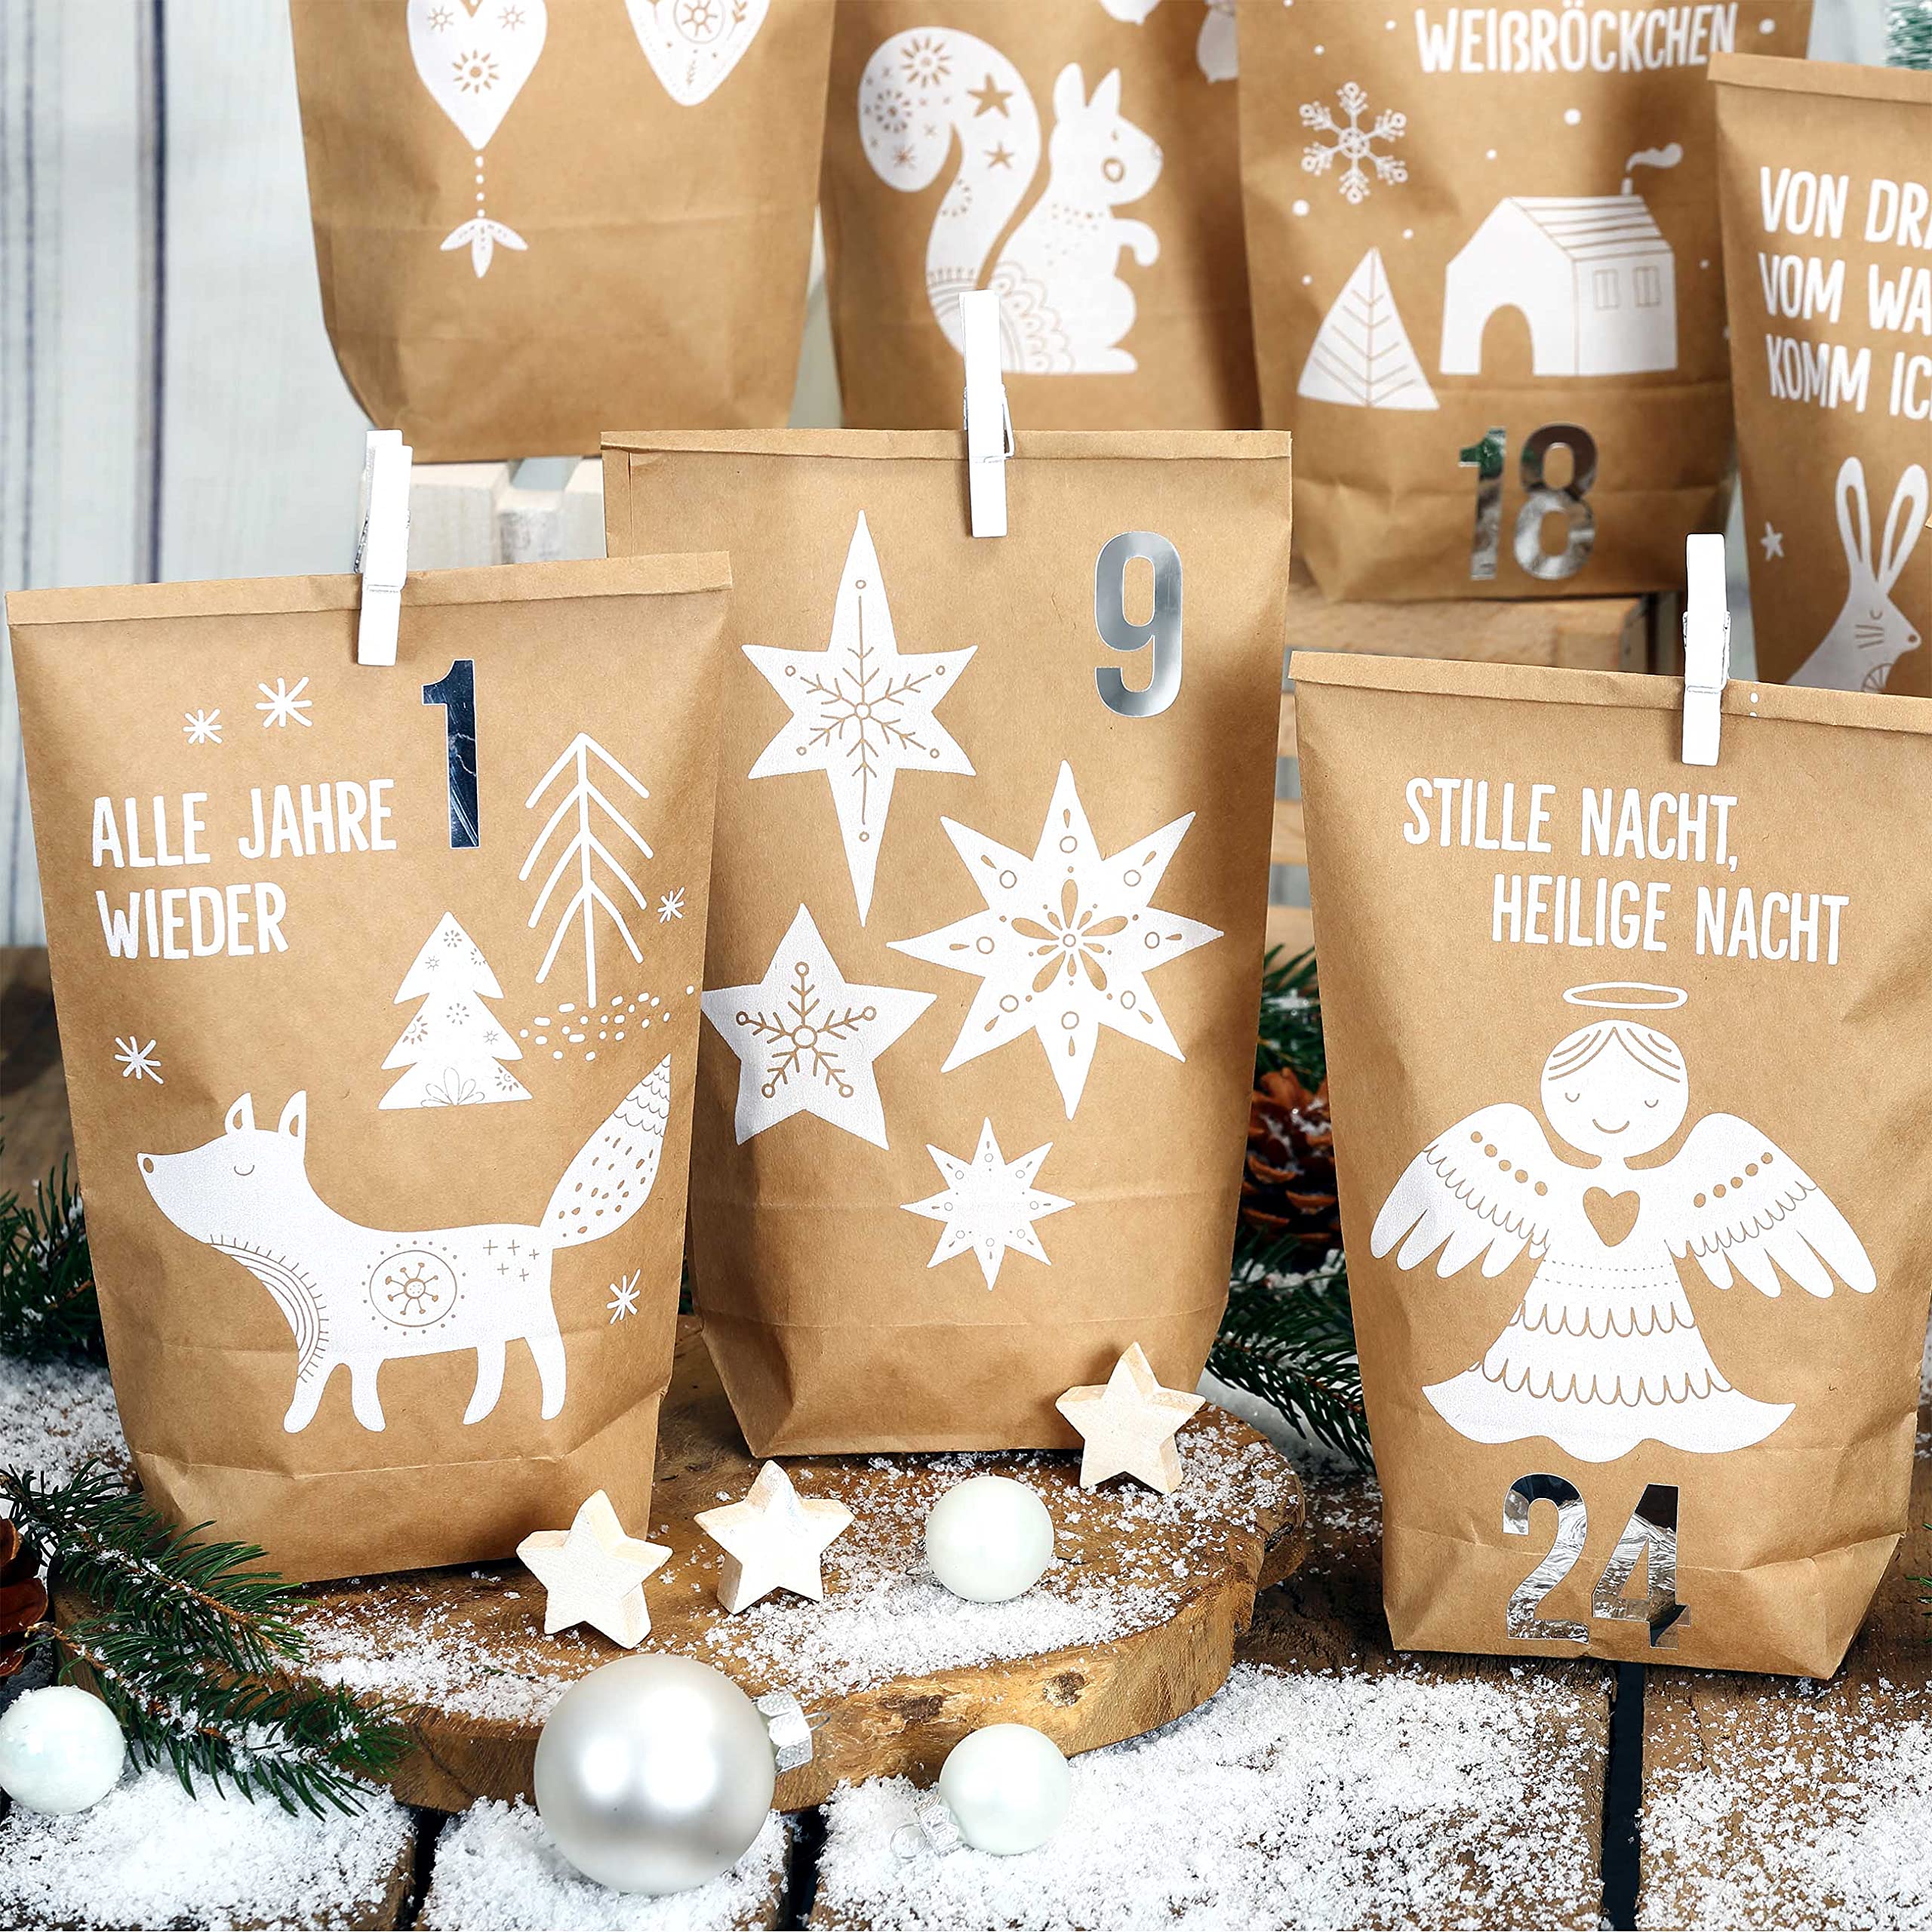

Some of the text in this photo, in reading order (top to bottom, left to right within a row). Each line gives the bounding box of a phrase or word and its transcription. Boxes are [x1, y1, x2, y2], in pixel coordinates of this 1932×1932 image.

[1414, 0, 1739, 73] WEIßRÖCKCHEN
[1760, 166, 1932, 250] VON DR
[1758, 252, 1846, 324] VOM
[1765, 333, 1932, 421] KOMM IC
[1458, 422, 1598, 581] 18
[1094, 531, 1183, 718] 9
[422, 659, 481, 849] 1
[91, 778, 398, 868] ALLE JAHRE
[1402, 777, 1739, 872] STILLE NACHT,
[95, 881, 290, 960] WIEDER
[1491, 873, 1850, 966] HEILIGE NACHT
[1503, 1472, 1690, 1649] 24
